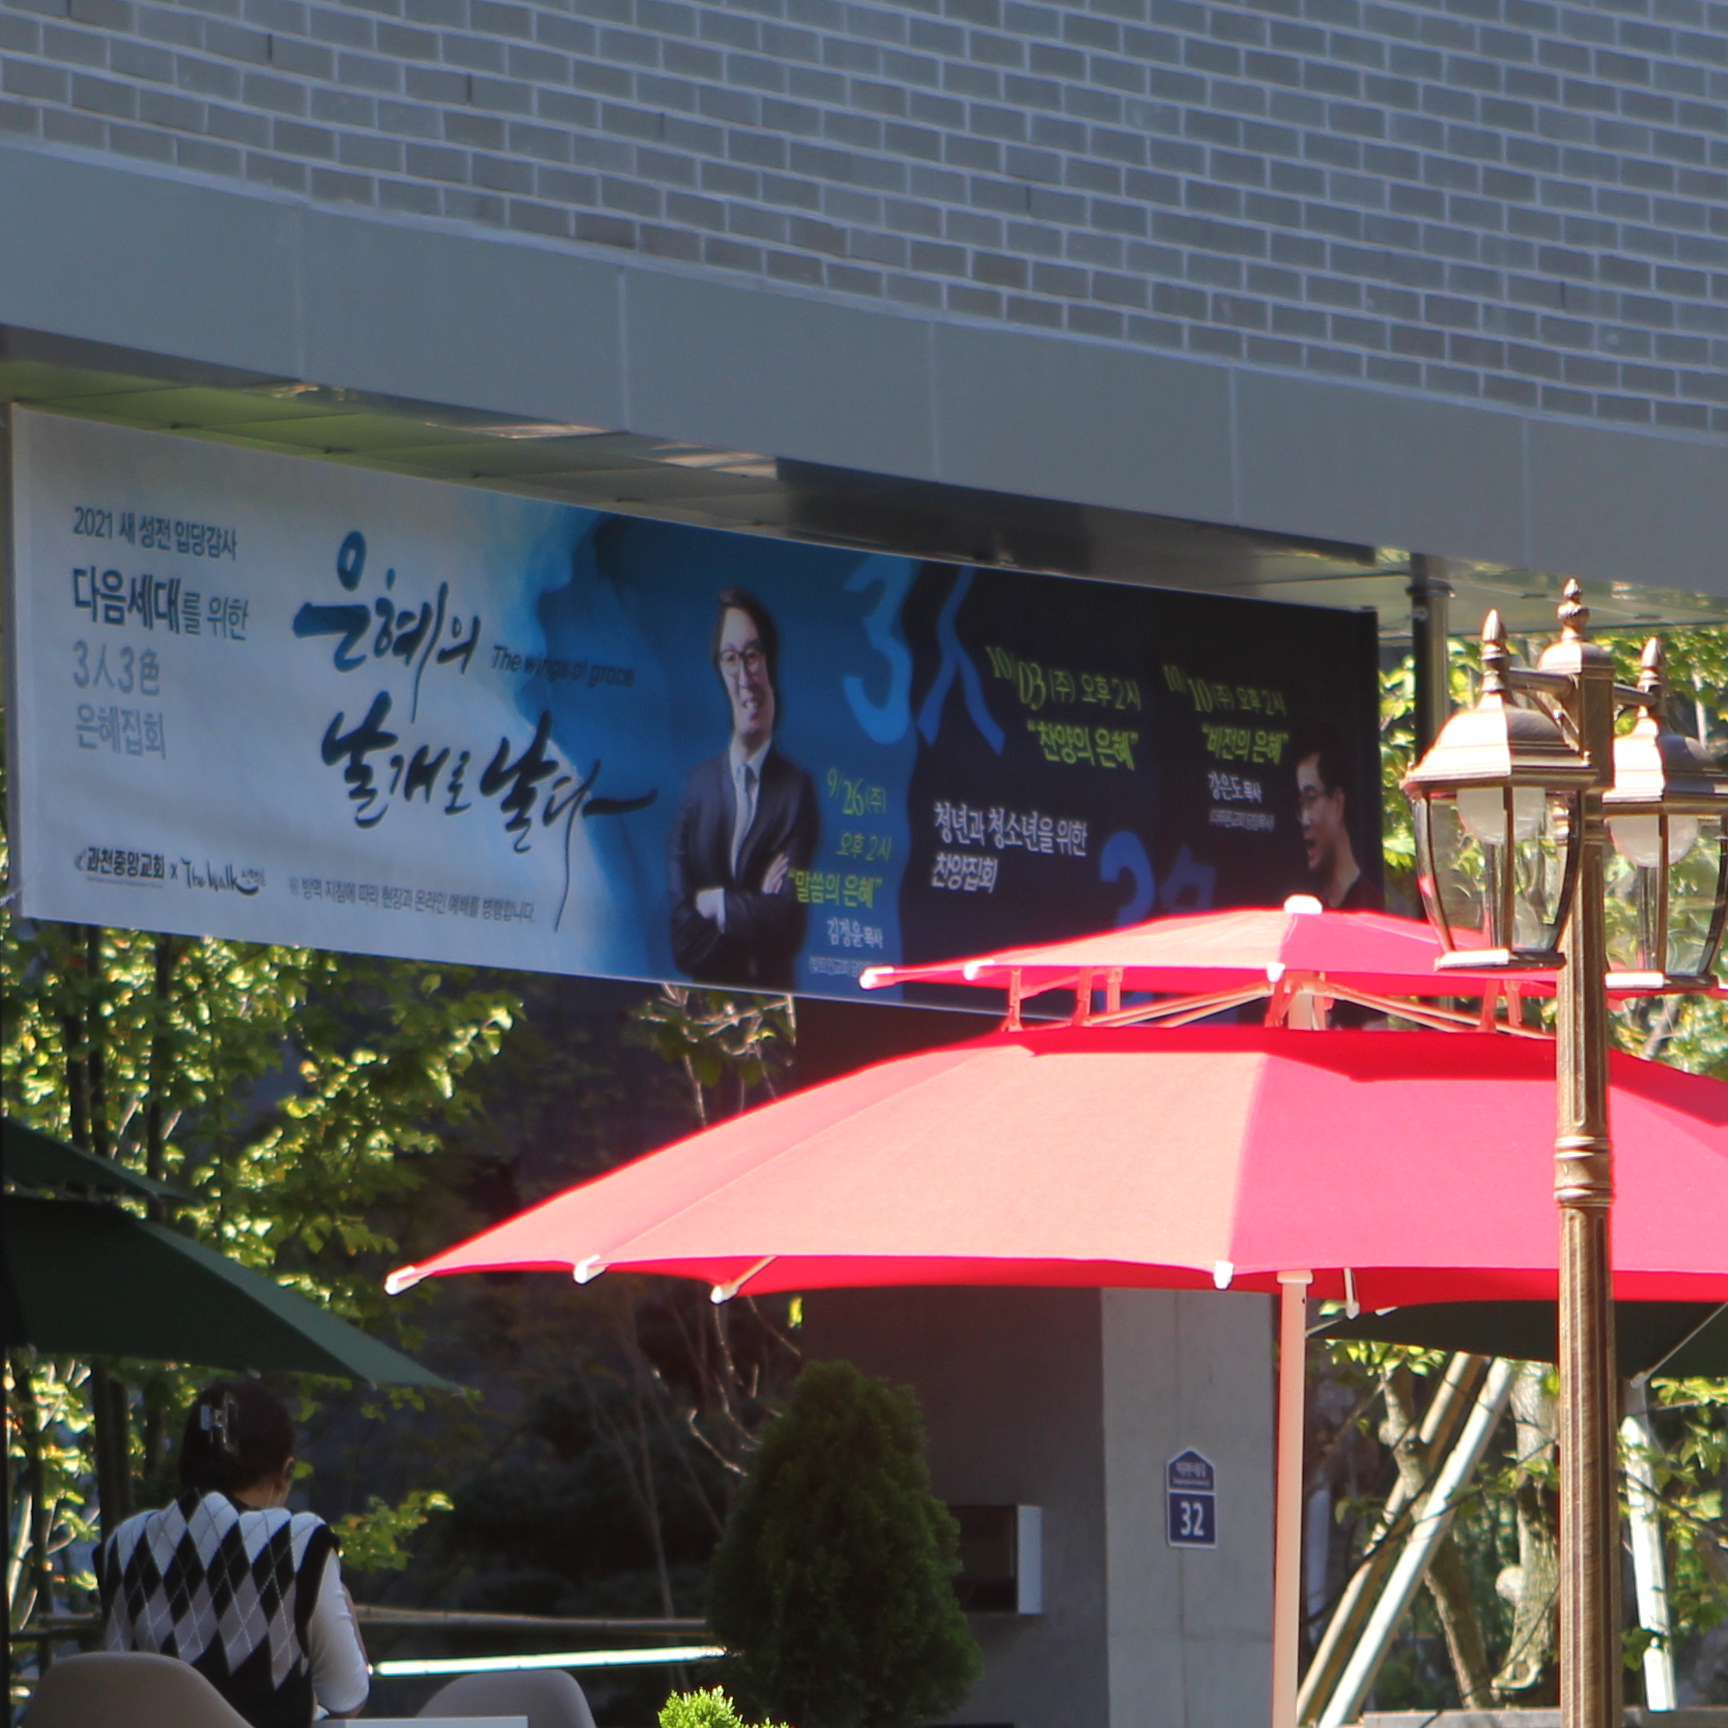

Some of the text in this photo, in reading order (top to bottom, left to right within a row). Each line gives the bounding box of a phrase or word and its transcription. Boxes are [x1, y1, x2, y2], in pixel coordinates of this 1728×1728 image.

[73, 506, 237, 561] 2021 새 성전 입당감사
[73, 565, 249, 641] 다음세대를 위한
[293, 531, 480, 724] 은혜의
[73, 640, 160, 696] 3人3色
[492, 645, 521, 672] The
[1081, 672, 1111, 707] 오후
[76, 703, 167, 760] 은혜집회
[322, 691, 659, 932] 날개로 날다
[934, 801, 1088, 857] 청년과 청소년을 위한
[87, 847, 165, 880] 과천중앙교회
[837, 833, 864, 858] 오후
[931, 852, 999, 893] 찬양집회
[1180, 1501, 1204, 1536] 32
